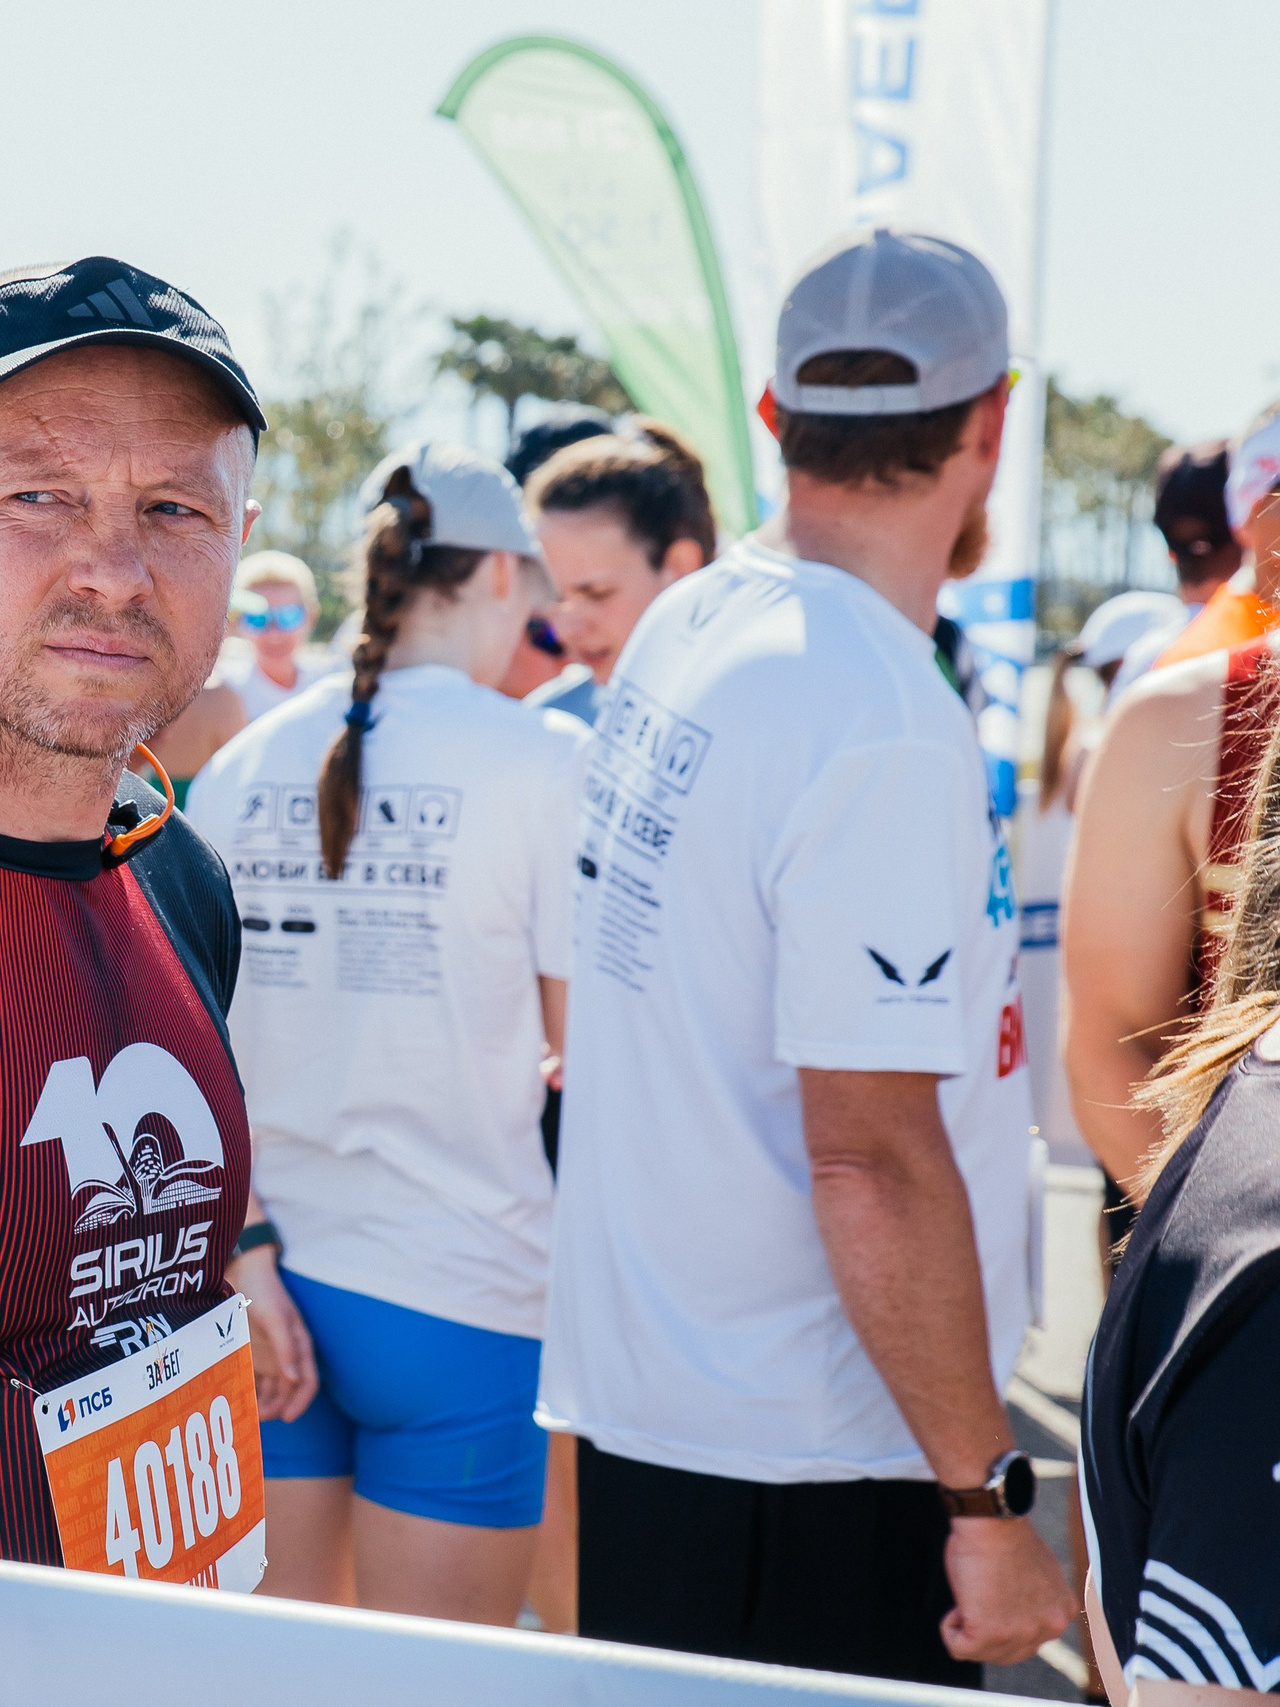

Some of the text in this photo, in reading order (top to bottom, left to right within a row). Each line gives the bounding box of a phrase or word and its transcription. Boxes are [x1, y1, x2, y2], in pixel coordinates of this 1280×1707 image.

[69, 1220, 214, 1299] SIRIUS
[146, 1348, 181, 1391] ЗА БЕГ
[78, 1386, 114, 1419] ПСБ
[105, 1394, 242, 1580] 40188
